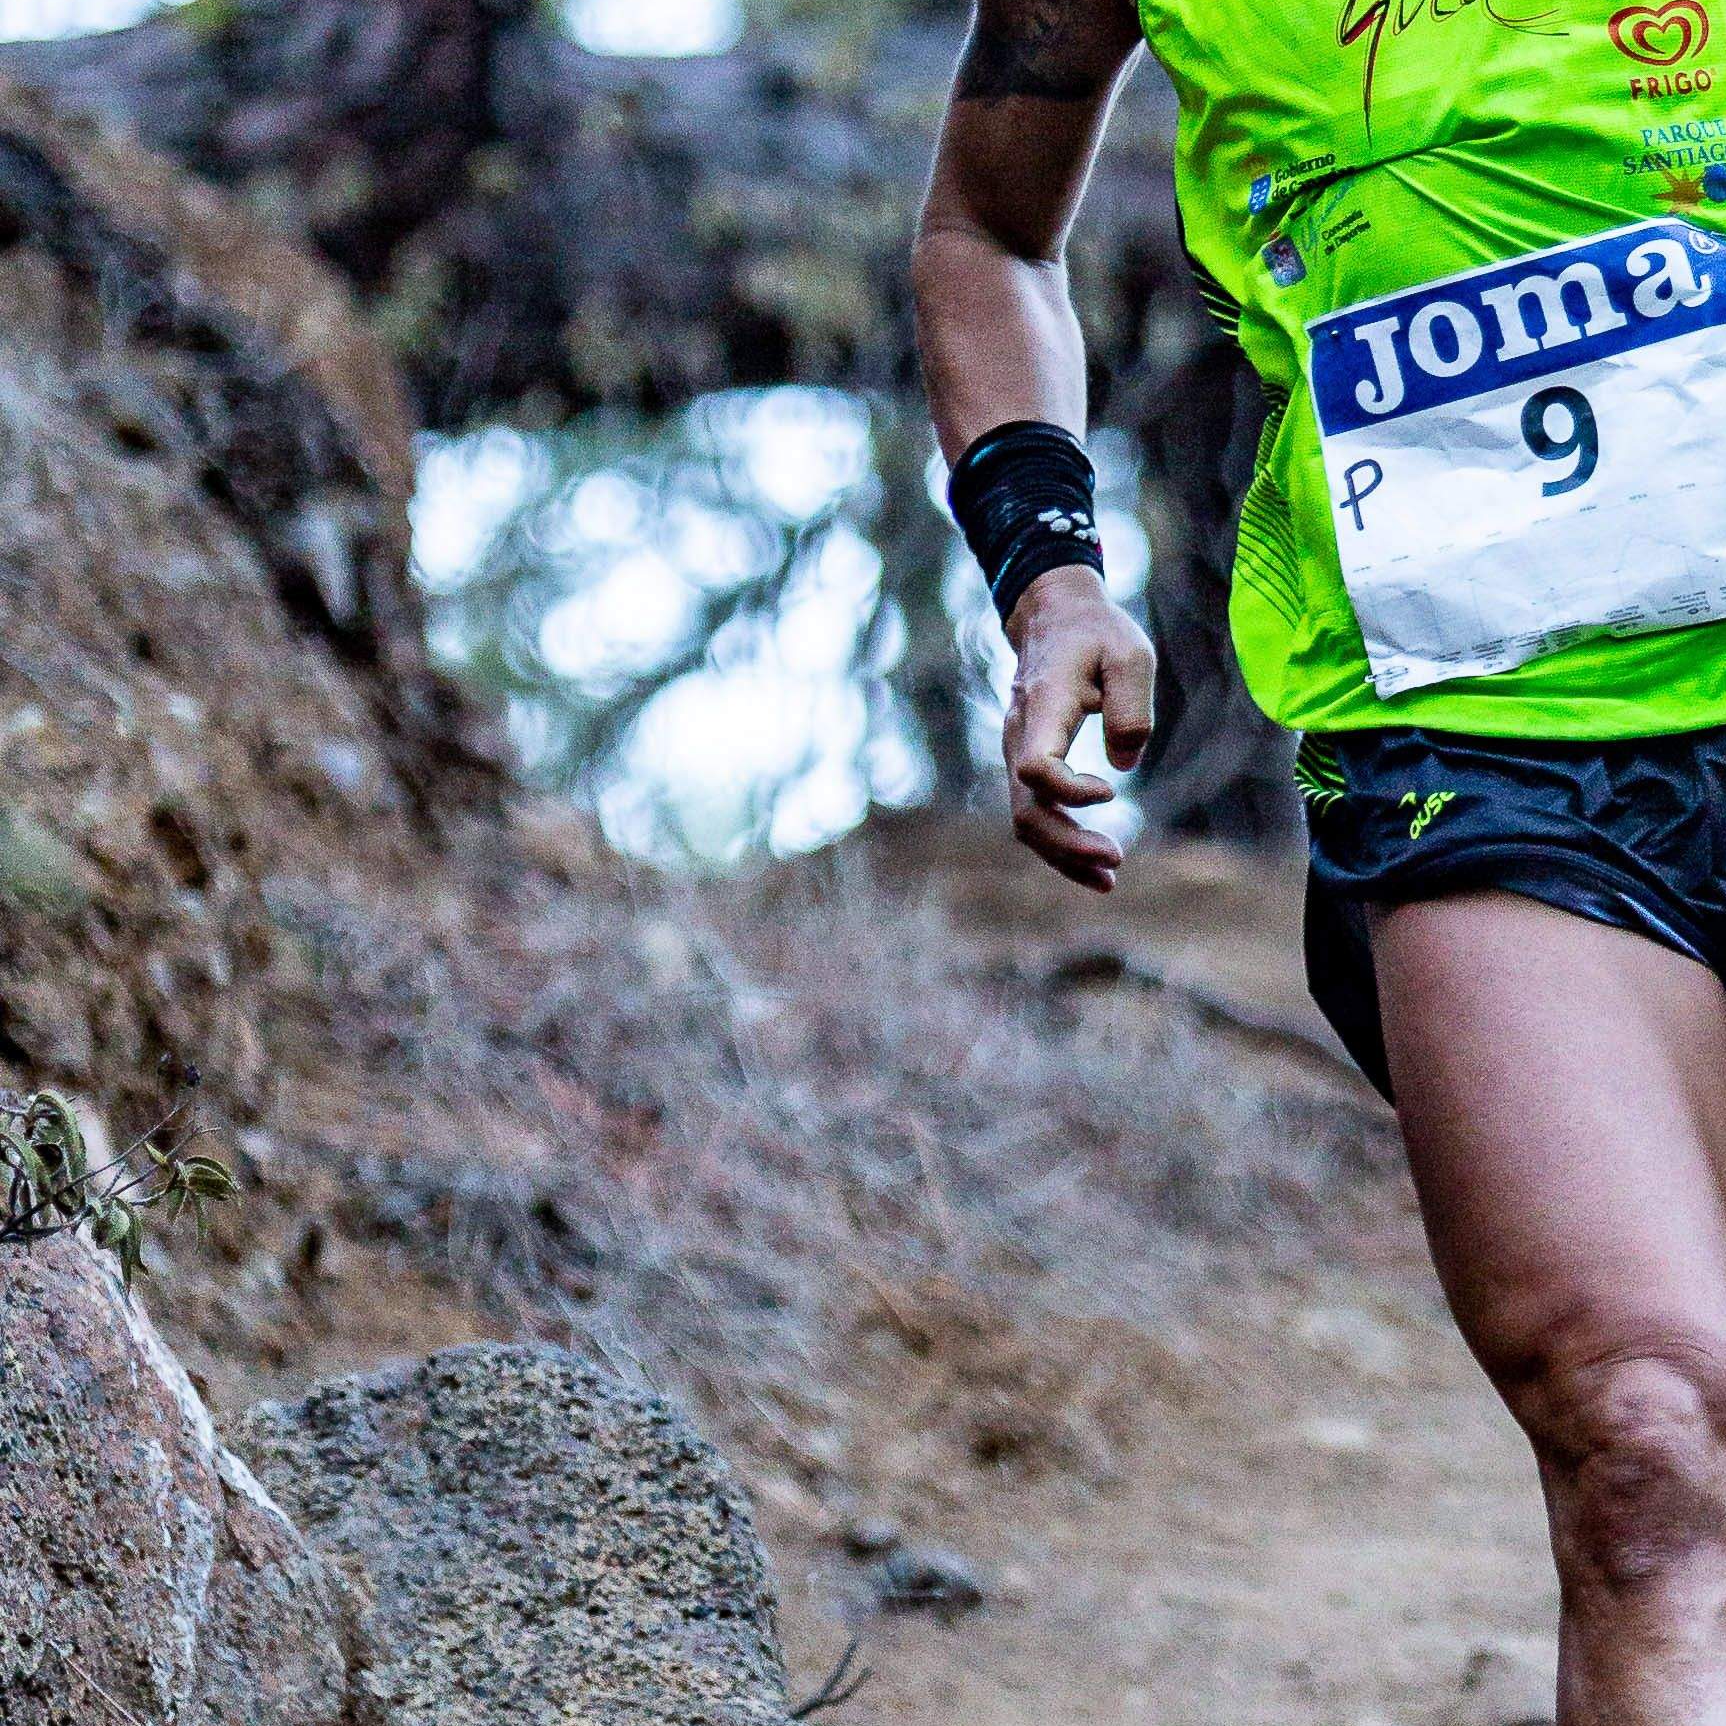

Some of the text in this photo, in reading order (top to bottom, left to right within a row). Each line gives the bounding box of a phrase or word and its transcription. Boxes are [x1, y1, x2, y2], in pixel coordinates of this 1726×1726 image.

[1630, 70, 1711, 100] FRIGO
[1274, 153, 1336, 184] Gobierno
[1520, 385, 1599, 498] 9
[1340, 459, 1383, 531] P
